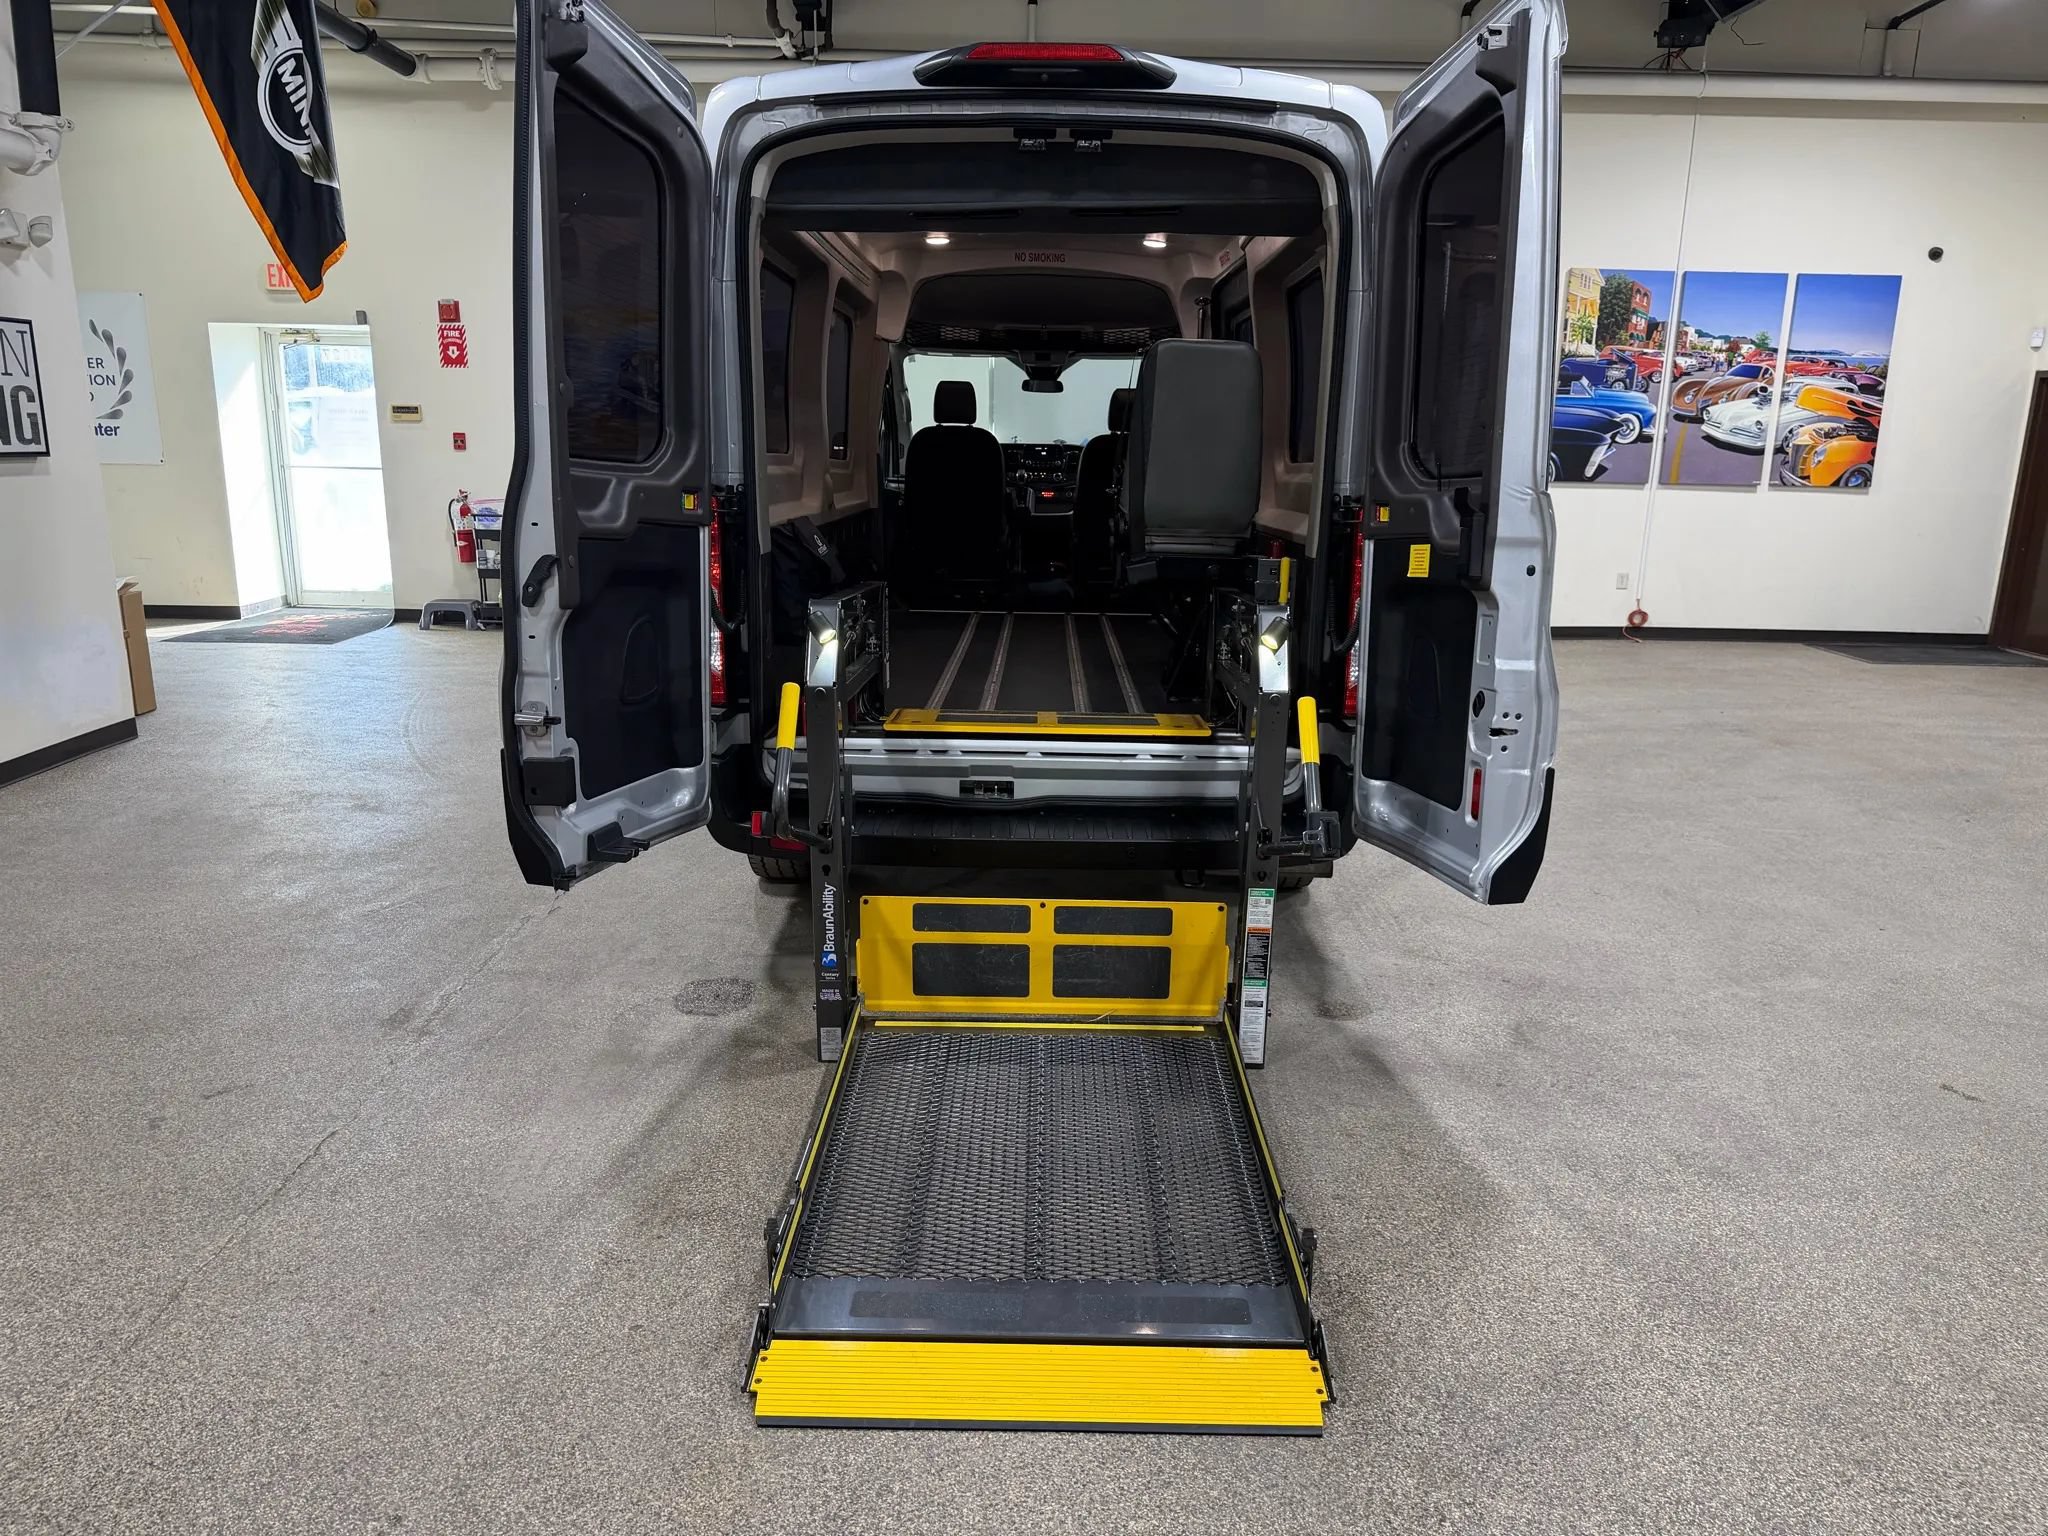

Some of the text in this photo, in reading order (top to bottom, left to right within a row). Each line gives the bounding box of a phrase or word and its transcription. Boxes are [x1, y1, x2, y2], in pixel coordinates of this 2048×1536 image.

[276, 57, 311, 137] MIN
[1014, 252, 1066, 263] NO SMOKING
[267, 263, 290, 288] EXI
[87, 357, 104, 369] ER
[87, 374, 116, 386] ION
[822, 882, 837, 952] BraunAbility
